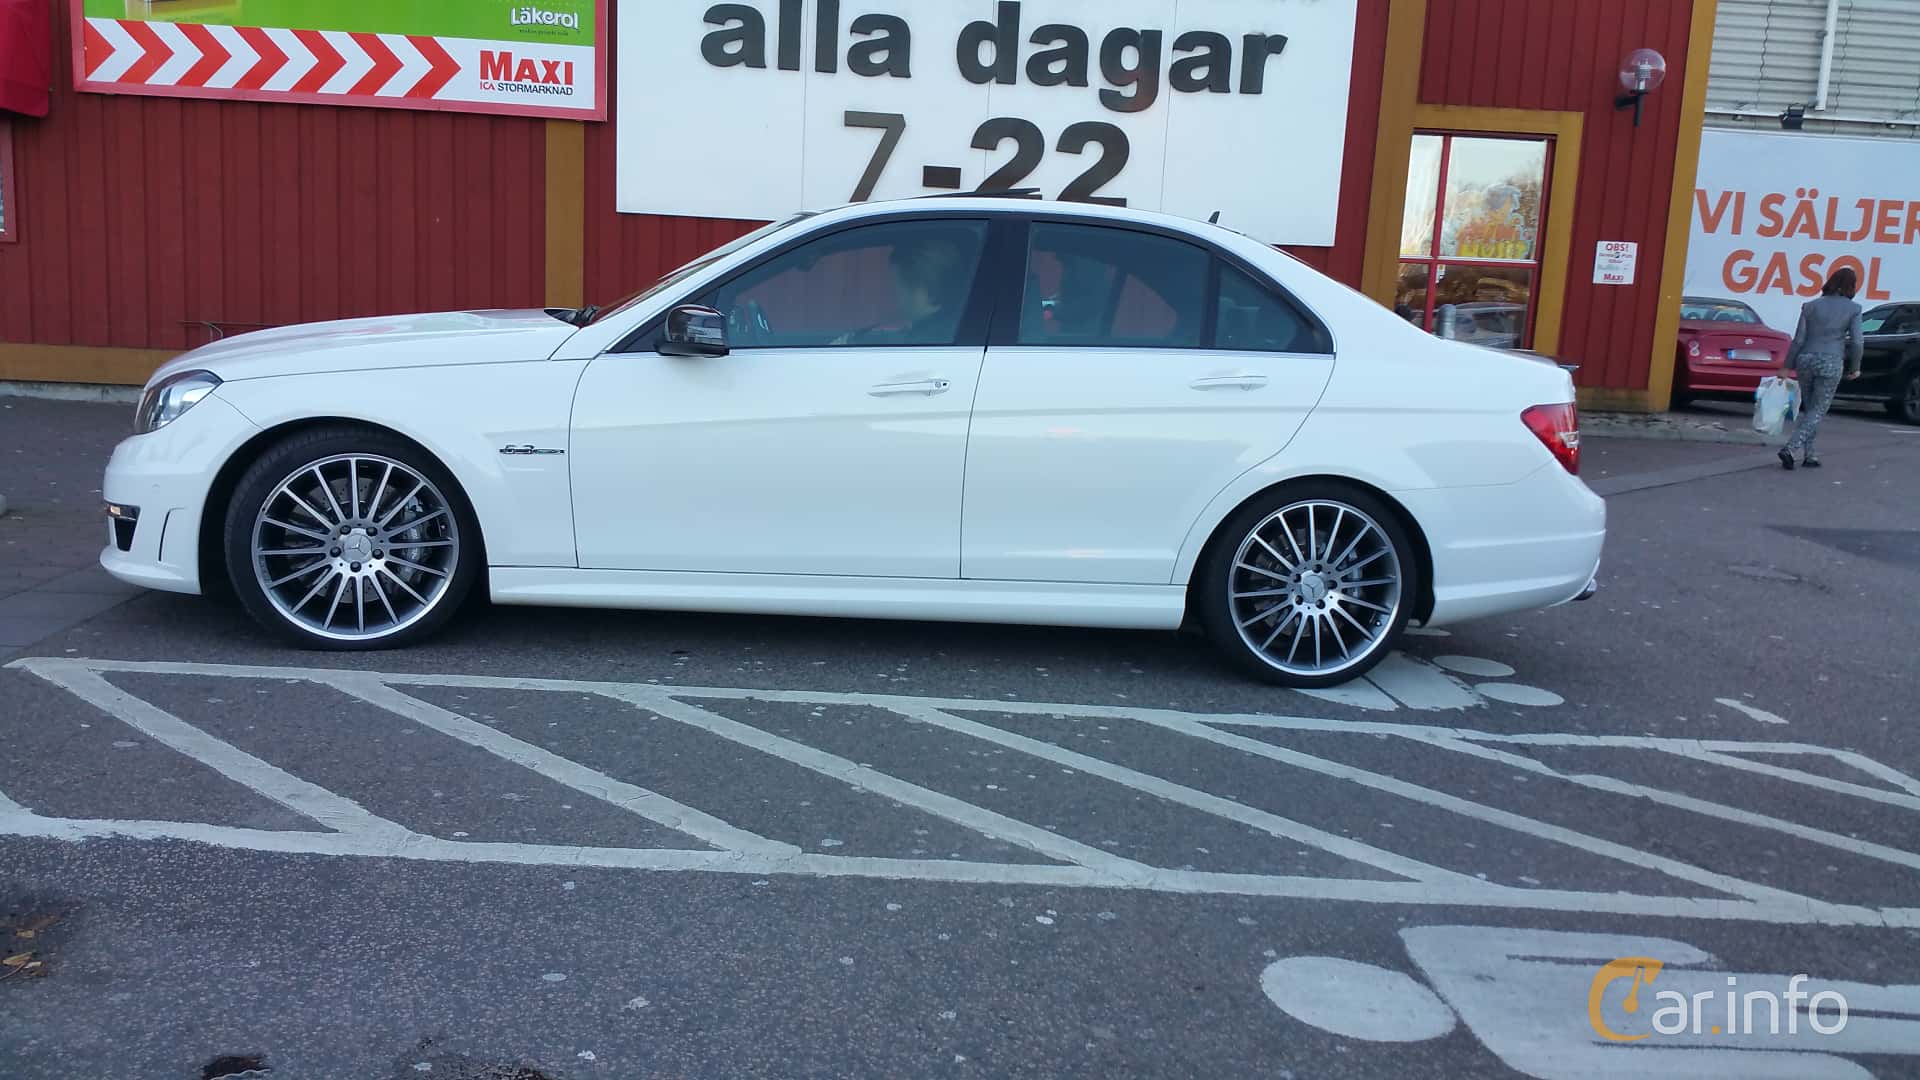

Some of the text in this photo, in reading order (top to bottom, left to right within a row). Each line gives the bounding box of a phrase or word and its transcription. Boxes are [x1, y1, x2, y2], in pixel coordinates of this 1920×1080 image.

[511, 7, 579, 30] Läkerol
[479, 50, 574, 86] MAXI
[700, 0, 1288, 113] alla dagar
[479, 81, 574, 96] ICA STORMARKNAD
[1695, 188, 1746, 235] VI
[1605, 242, 1629, 252] OBS!
[1722, 249, 1890, 300] GASOL
